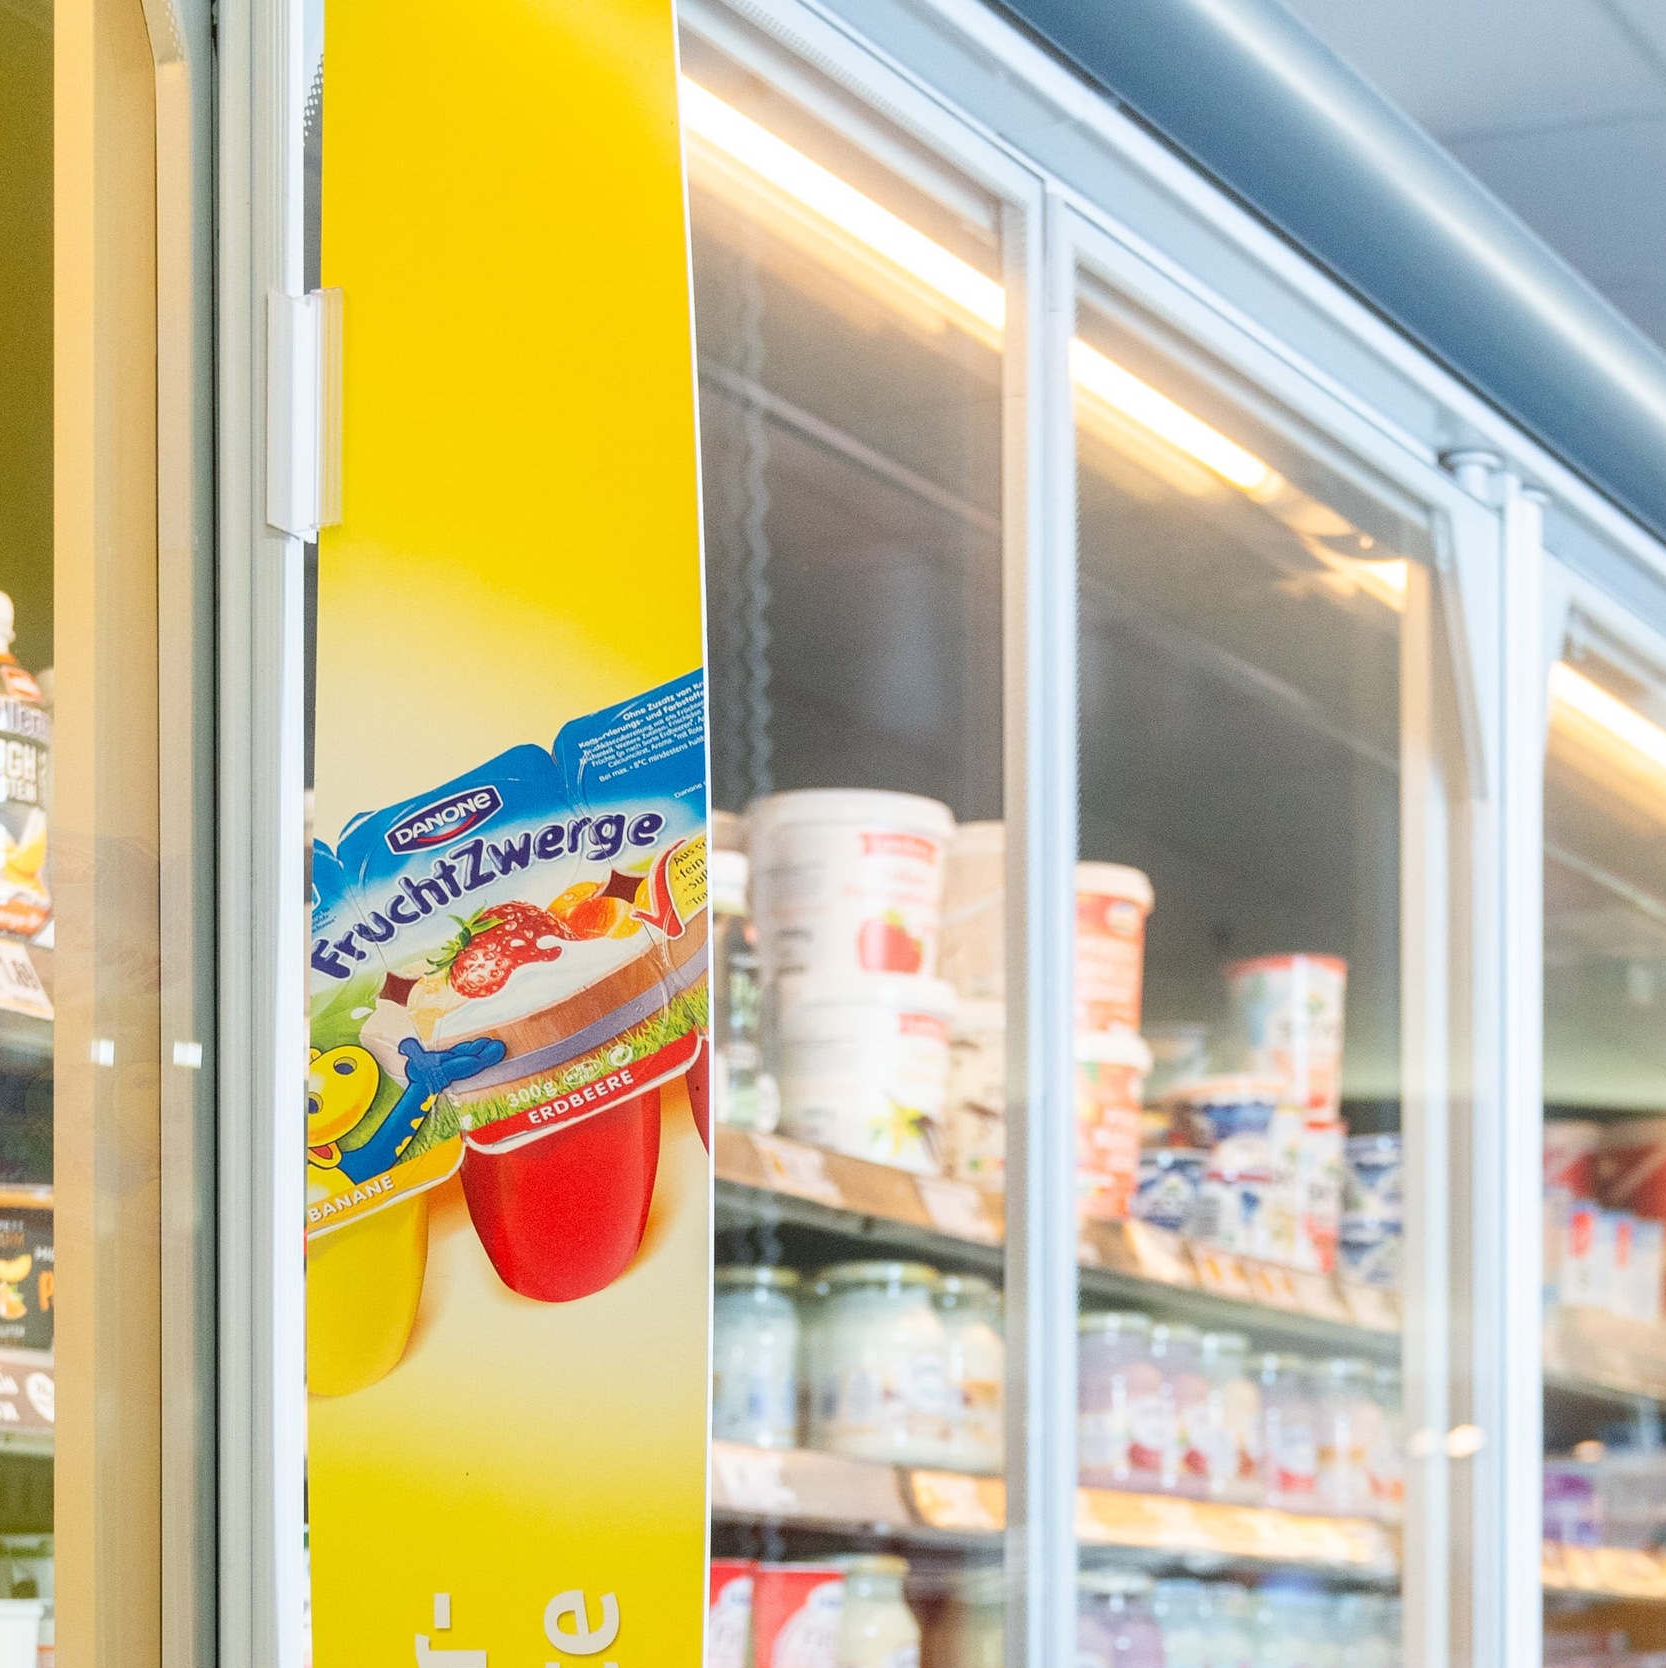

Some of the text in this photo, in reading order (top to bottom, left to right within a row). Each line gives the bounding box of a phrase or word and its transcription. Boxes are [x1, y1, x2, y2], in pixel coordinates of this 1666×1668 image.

[622, 707, 647, 722] Ohne
[675, 685, 692, 698] von
[645, 710, 663, 721] und
[647, 743, 688, 765] mindestens
[394, 789, 492, 847] DANONE
[679, 857, 705, 879] fein
[311, 811, 666, 980] FruchtZwerge
[527, 1069, 635, 1125] ERDBEERE
[307, 1175, 395, 1224] BANANE
